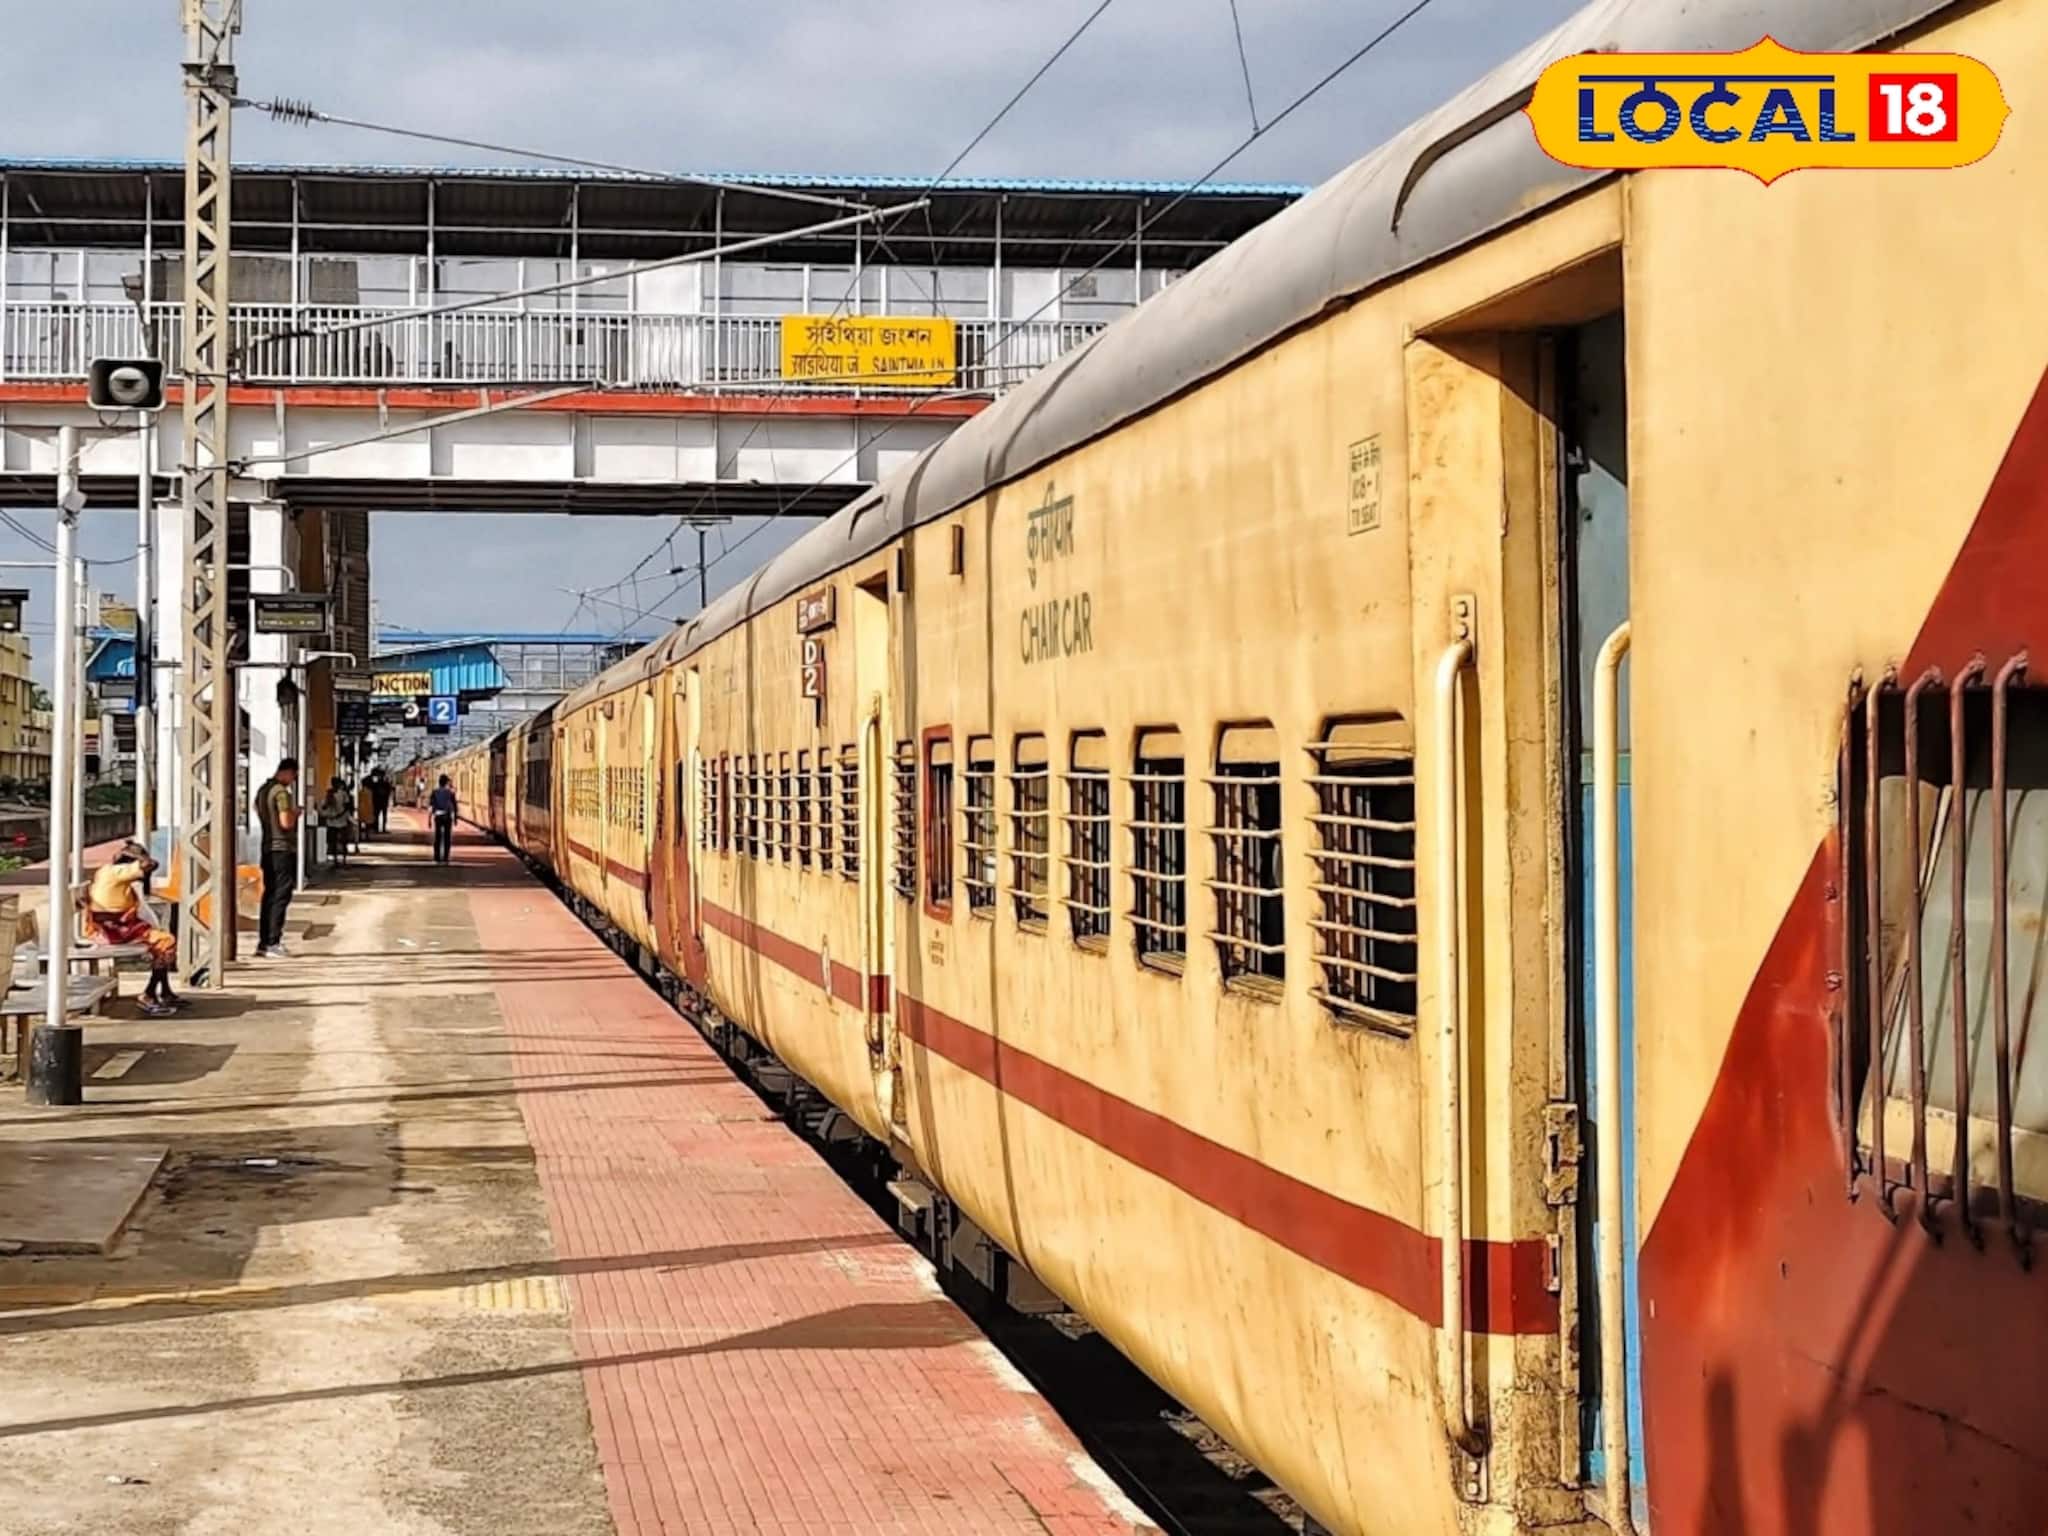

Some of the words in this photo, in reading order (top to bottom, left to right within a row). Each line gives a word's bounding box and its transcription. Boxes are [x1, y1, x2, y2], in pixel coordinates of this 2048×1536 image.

[1020, 599, 1060, 664] CHAIR
[1062, 592, 1093, 656] CAR
[436, 702, 450, 720] 2
